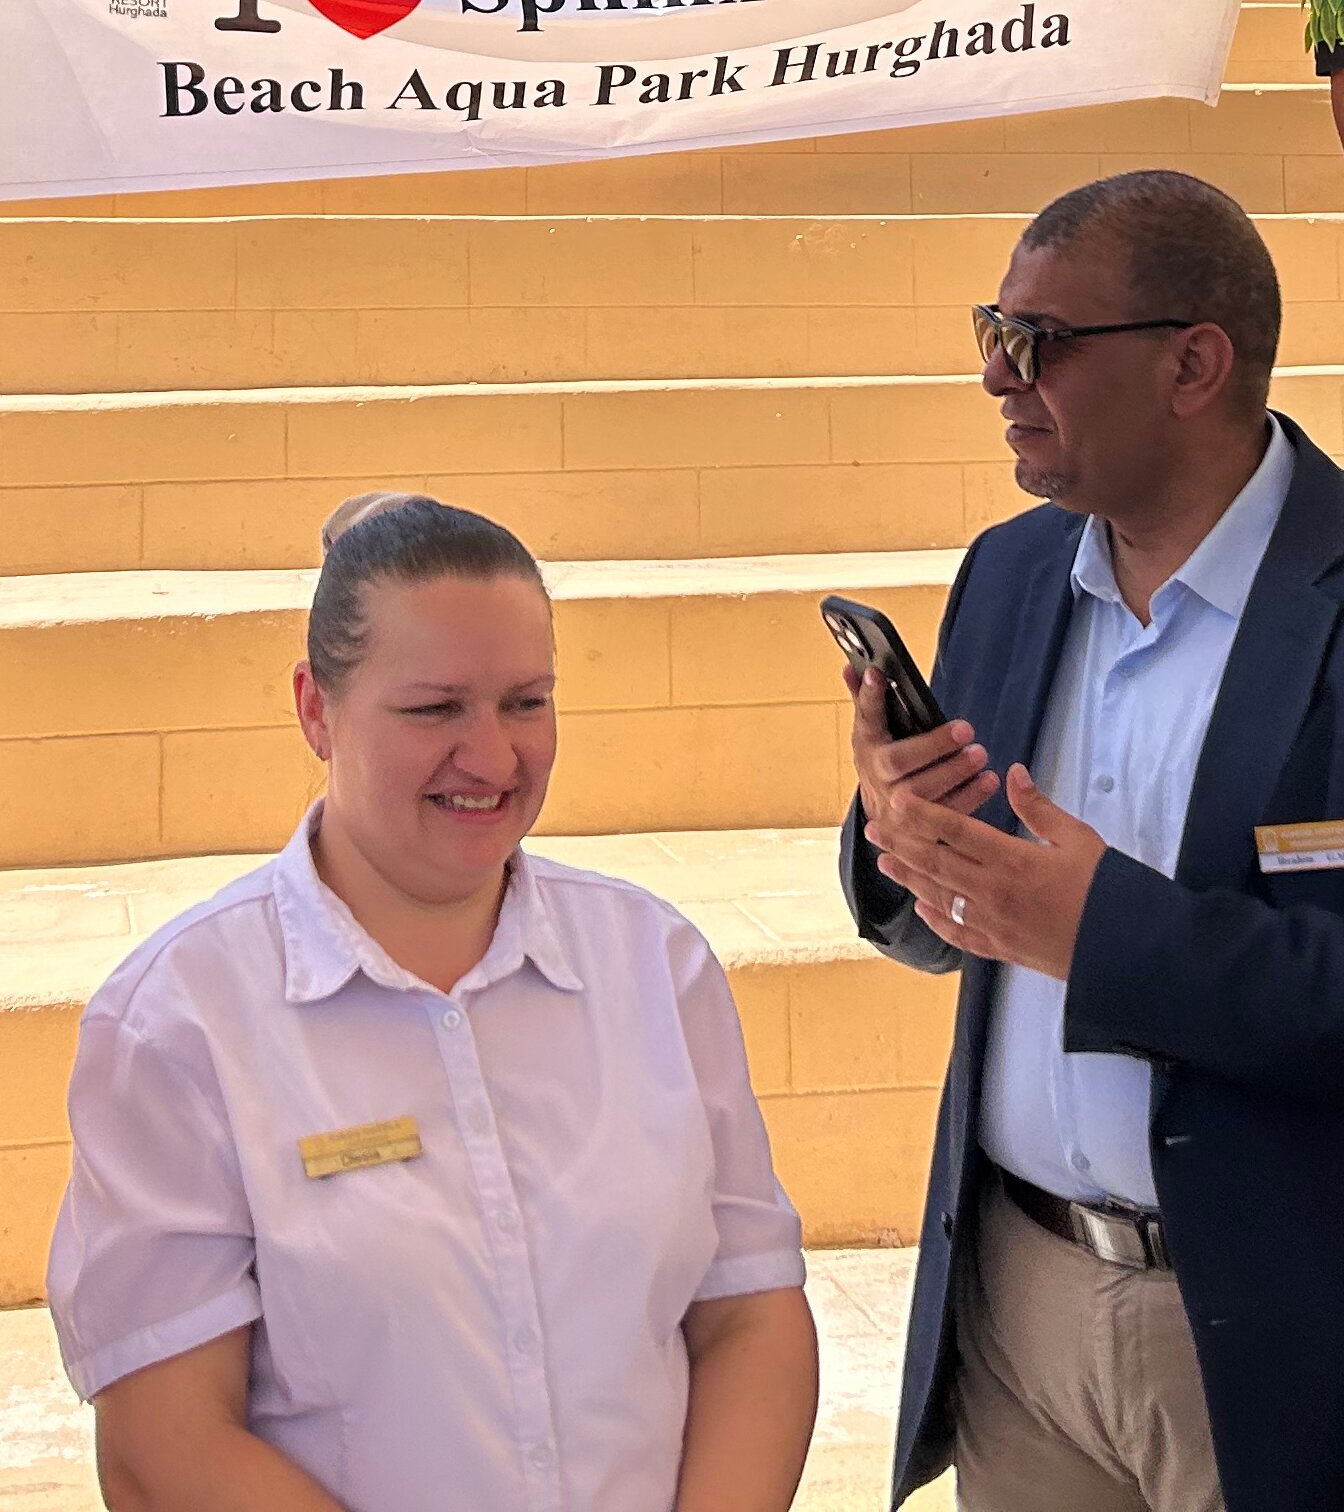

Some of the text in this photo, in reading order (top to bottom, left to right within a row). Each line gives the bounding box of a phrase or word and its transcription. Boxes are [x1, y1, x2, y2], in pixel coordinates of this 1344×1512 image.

[108, 3, 168, 19] Hurghada
[156, 2, 1072, 122] Beach Aqua Park Hurghada
